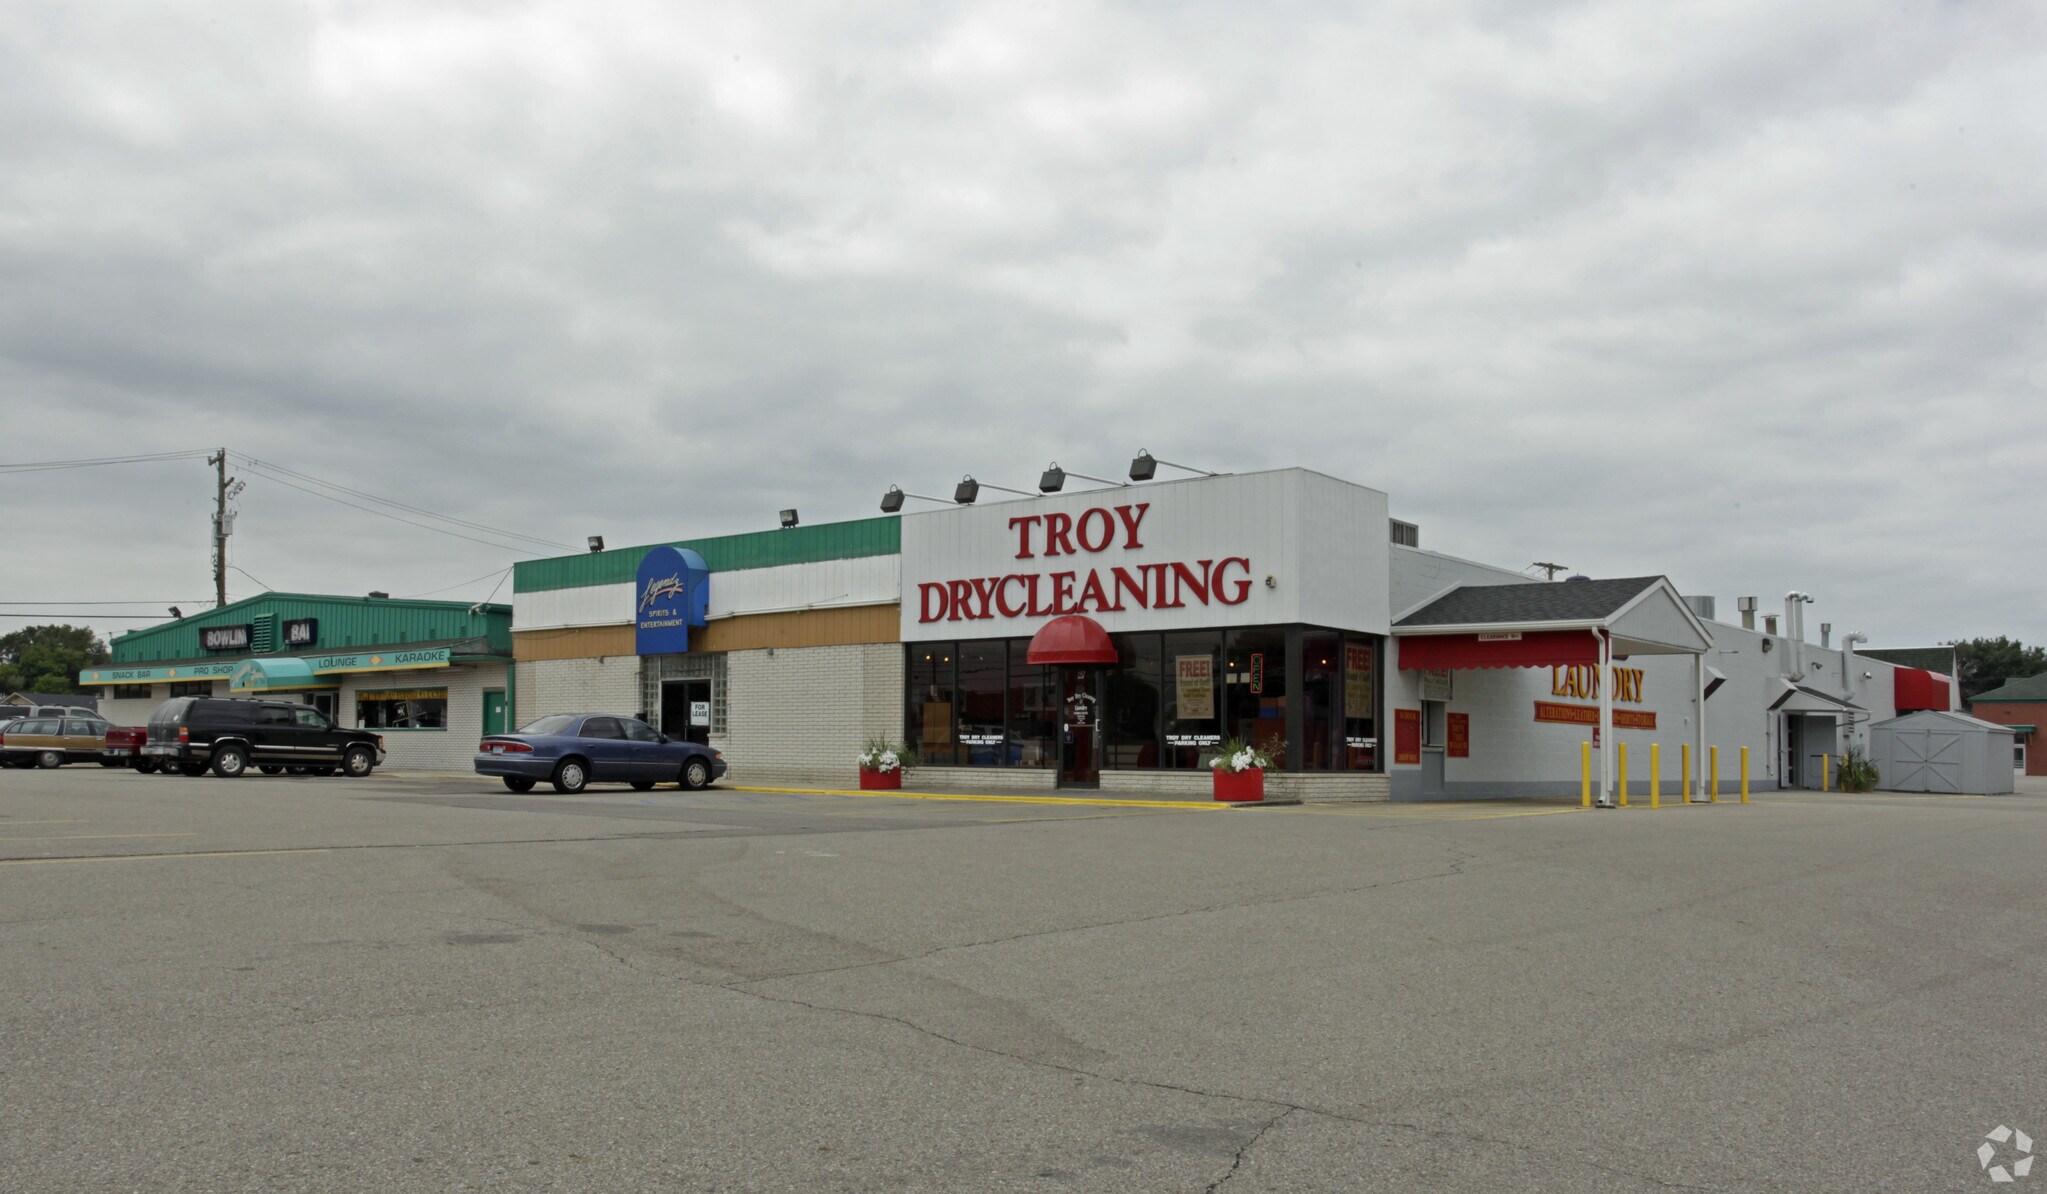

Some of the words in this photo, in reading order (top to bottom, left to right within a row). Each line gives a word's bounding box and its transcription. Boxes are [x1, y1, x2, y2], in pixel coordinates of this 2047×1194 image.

[1008, 502, 1150, 559] TROY
[917, 556, 1253, 624] DRYCLEANING
[648, 609, 669, 617] SPIRITS
[672, 608, 677, 616] &
[640, 618, 683, 629] ENTERTAINMENT
[318, 656, 357, 669] LOUNGE
[394, 651, 445, 664] KARAOKE
[112, 671, 134, 680] SNACK
[137, 670, 151, 679] BAR
[194, 666, 209, 675] PRO
[212, 665, 234, 675] SHOP
[1179, 660, 1210, 678] FREE!
[1253, 656, 1261, 690] OPEN
